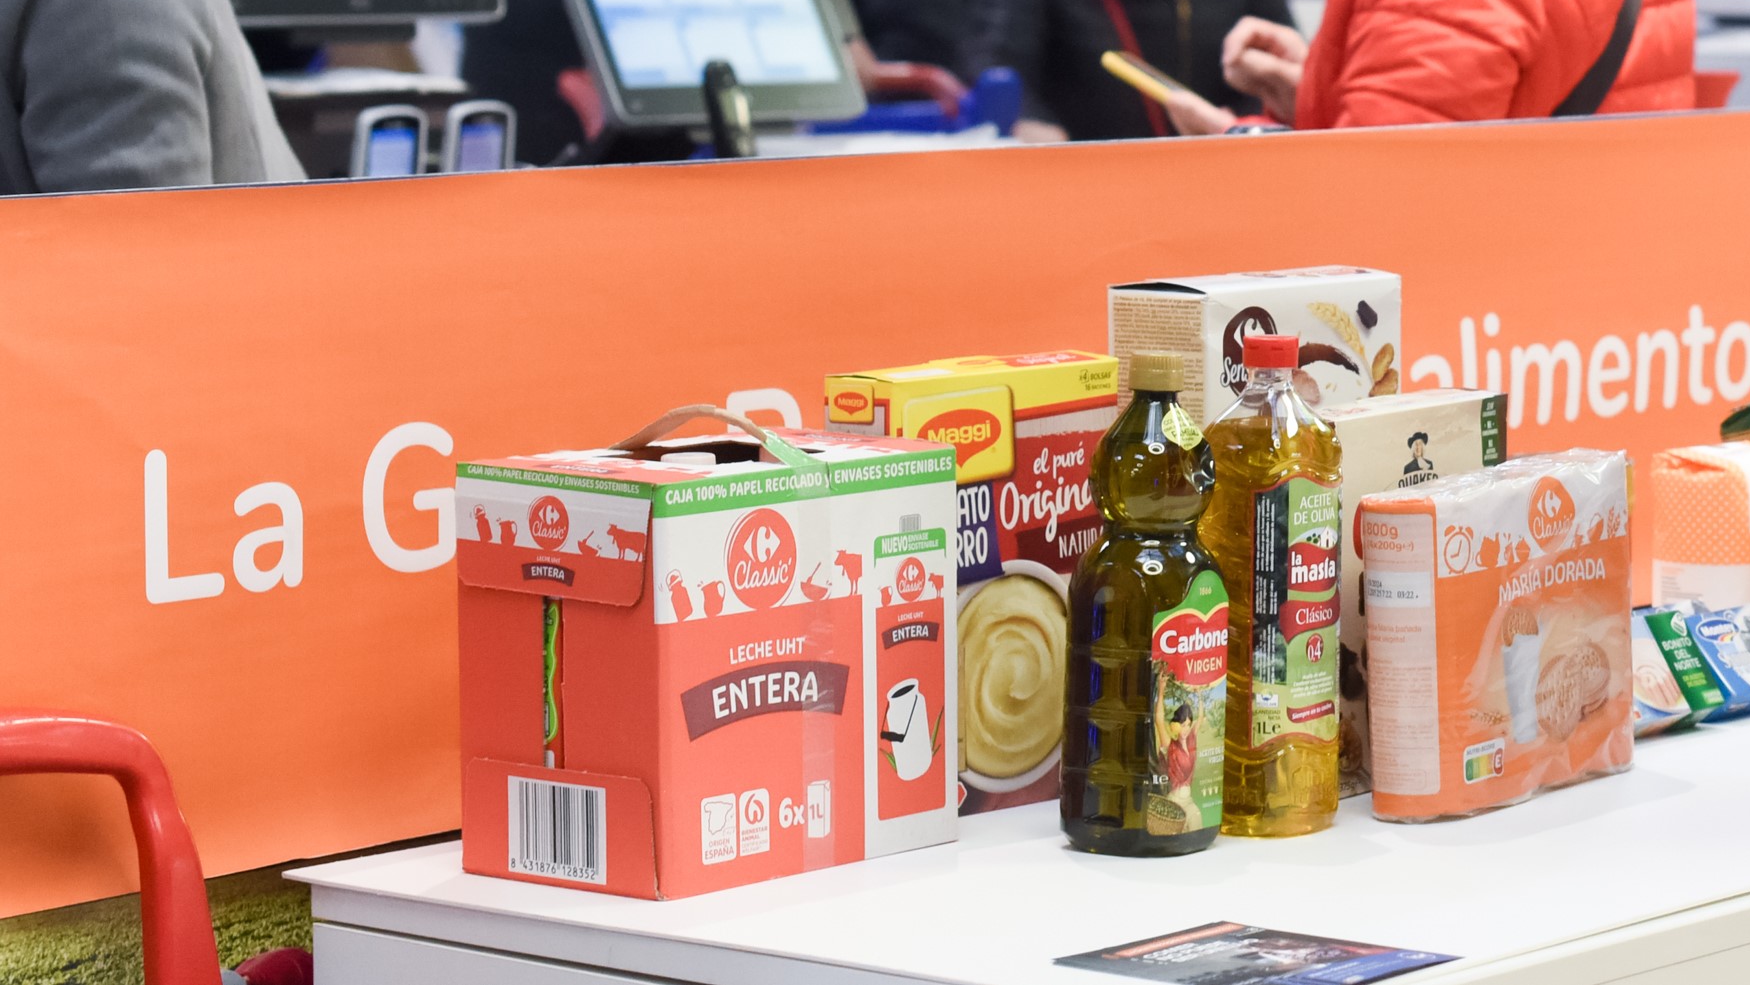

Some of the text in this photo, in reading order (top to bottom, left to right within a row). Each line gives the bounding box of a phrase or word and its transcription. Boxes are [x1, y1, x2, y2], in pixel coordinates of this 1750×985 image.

[838, 398, 865, 408] Maggi
[928, 420, 991, 444] Maggi
[1033, 441, 1085, 479] el puré
[467, 464, 484, 475] CAJA
[484, 467, 502, 478] 100%
[502, 469, 523, 481] PAPEL
[523, 471, 559, 484] RECICLADO
[564, 477, 595, 489] ENVASES
[595, 480, 640, 494] SOSTENIBLES
[665, 457, 952, 505] CAJA 100% PAPEL RECICLADO y ENVASES SOSTENIBLES
[957, 485, 990, 528] ATO
[1300, 492, 1331, 509] ACEITE
[1294, 506, 1335, 525] DE OLIVA
[144, 448, 304, 604] La
[1366, 522, 1398, 539] 800g
[882, 535, 908, 554] NUEVO
[957, 527, 988, 568] RRO
[1291, 551, 1302, 566] la
[531, 566, 565, 580] ENTERA
[734, 557, 792, 590] Classic
[1291, 556, 1336, 584] masía
[1499, 558, 1605, 607] MARÍA DORADA
[1295, 606, 1333, 625] Clásico
[892, 625, 929, 642] ENTERA
[1160, 627, 1228, 654] Carbone
[729, 637, 806, 664] LECHE UHT
[1661, 638, 1692, 651] BONITO
[1674, 648, 1691, 660] DEL
[1186, 656, 1223, 675] VIRGEN
[1673, 658, 1701, 671] NORTE
[712, 671, 818, 719] ENTERA
[708, 838, 730, 847] ORIGEN
[705, 846, 735, 860] ESPAÑA
[511, 858, 596, 880] 8 431876 128352
